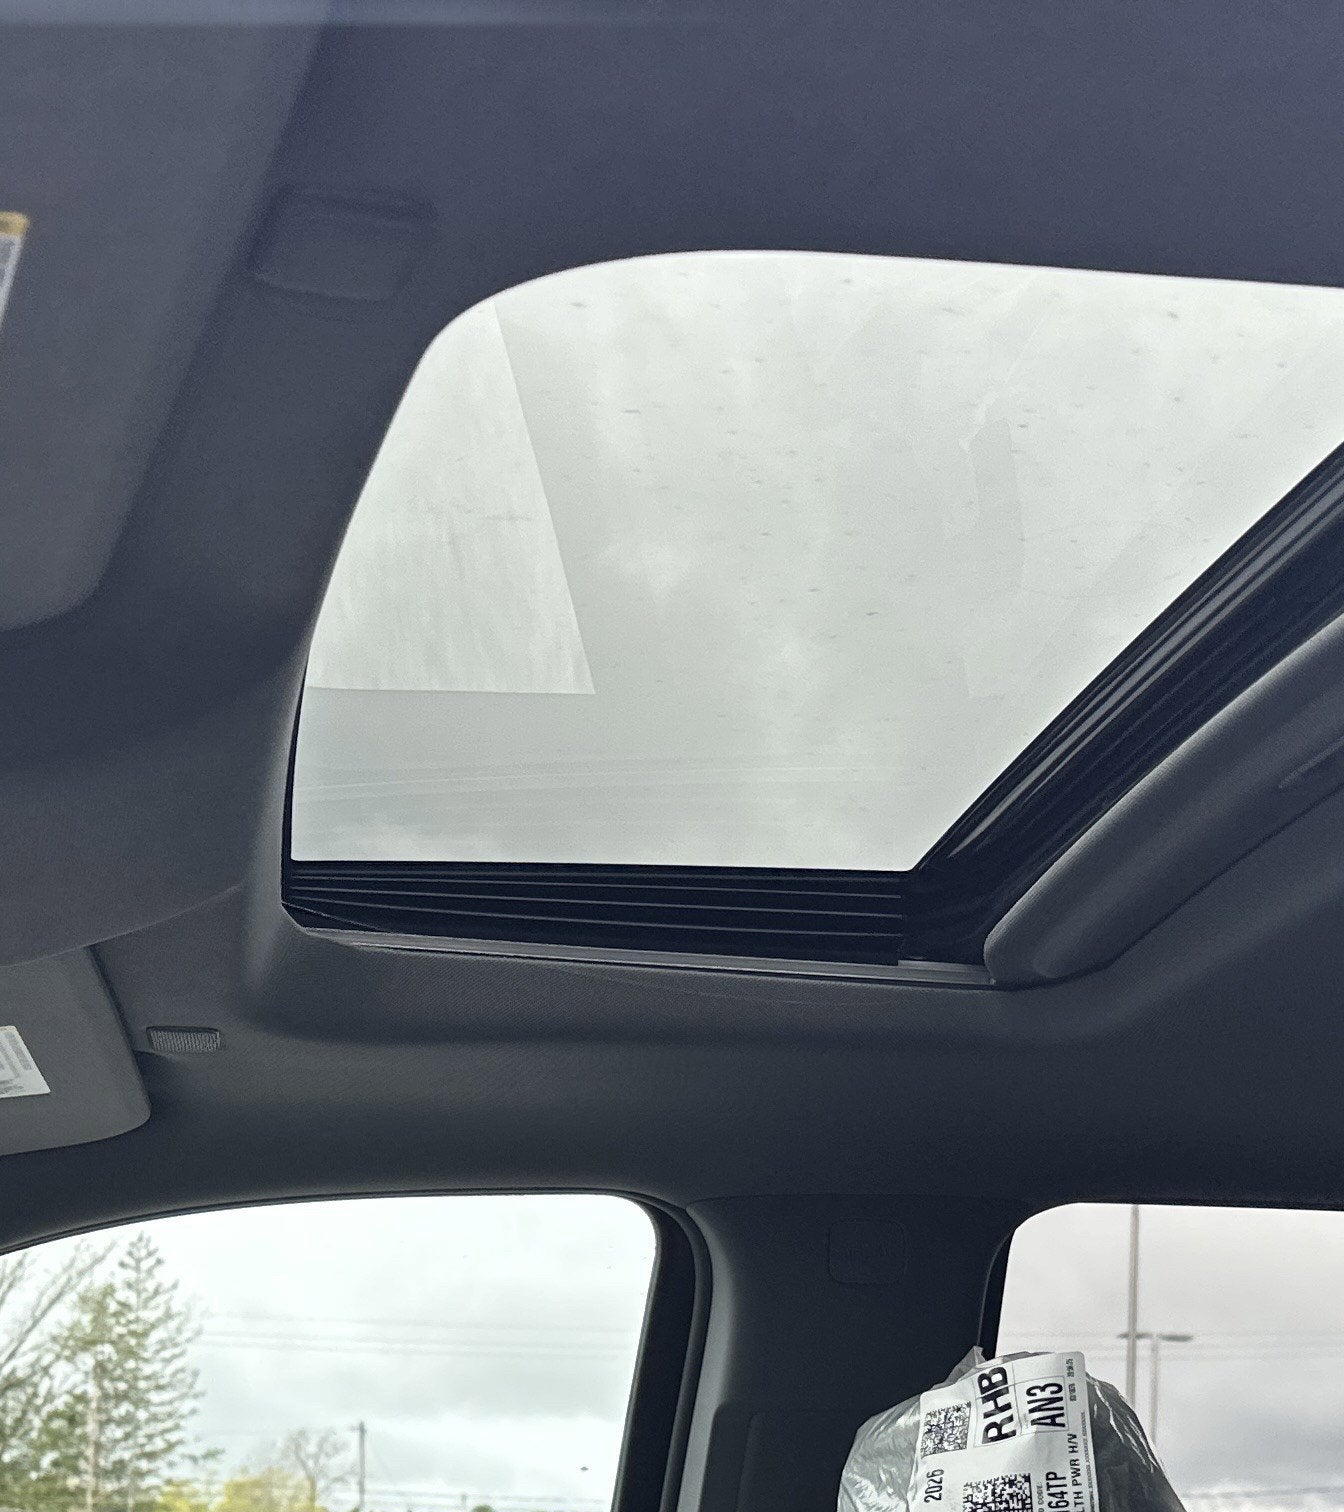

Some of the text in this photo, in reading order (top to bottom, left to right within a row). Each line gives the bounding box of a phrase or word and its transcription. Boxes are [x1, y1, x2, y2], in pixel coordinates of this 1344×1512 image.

[977, 1366, 1017, 1445] RHB
[1026, 1382, 1066, 1429] AN3
[1067, 1433, 1079, 1454] H/V
[924, 1469, 945, 1504] 2026
[1069, 1458, 1082, 1487] PWR
